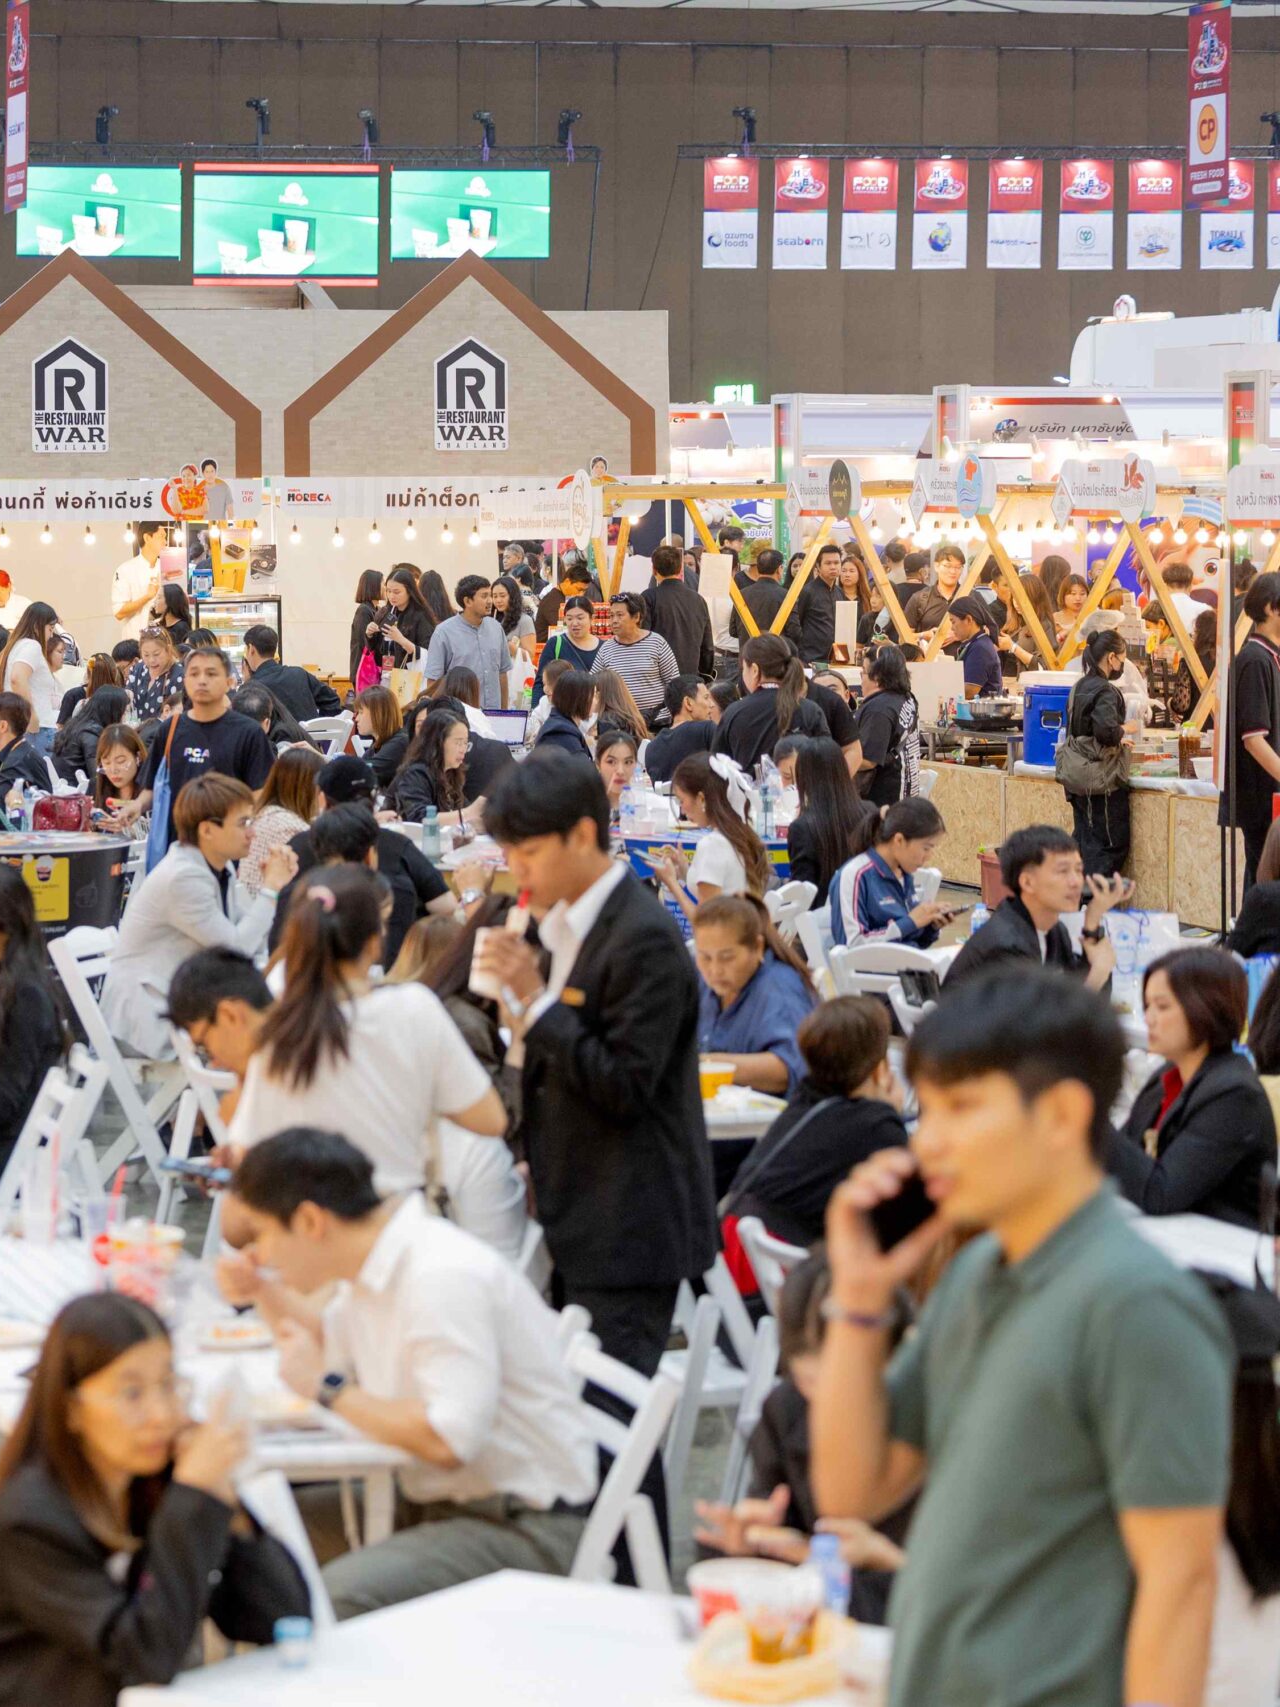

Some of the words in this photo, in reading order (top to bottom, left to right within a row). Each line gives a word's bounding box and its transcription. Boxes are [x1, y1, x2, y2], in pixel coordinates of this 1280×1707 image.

[1200, 118, 1215, 141] CP
[713, 175, 749, 185] FOOD
[853, 176, 888, 186] FOOD
[998, 176, 1033, 186] FOOD
[1138, 176, 1173, 186] FOOD
[1190, 170, 1208, 181] FRESH
[777, 235, 824, 246] seaborn
[54, 369, 86, 410] R
[456, 368, 486, 409] R
[35, 412, 44, 425] THE
[45, 412, 105, 425] RESTAURANT
[437, 411, 446, 423] THE
[446, 411, 505, 424] RESTAURANT
[35, 427, 105, 443] WAR
[437, 425, 505, 440] WAR
[55, 490, 153, 509] พ่อค้าเดียร์
[288, 493, 331, 502] HORECA
[184, 747, 210, 758] PCA
